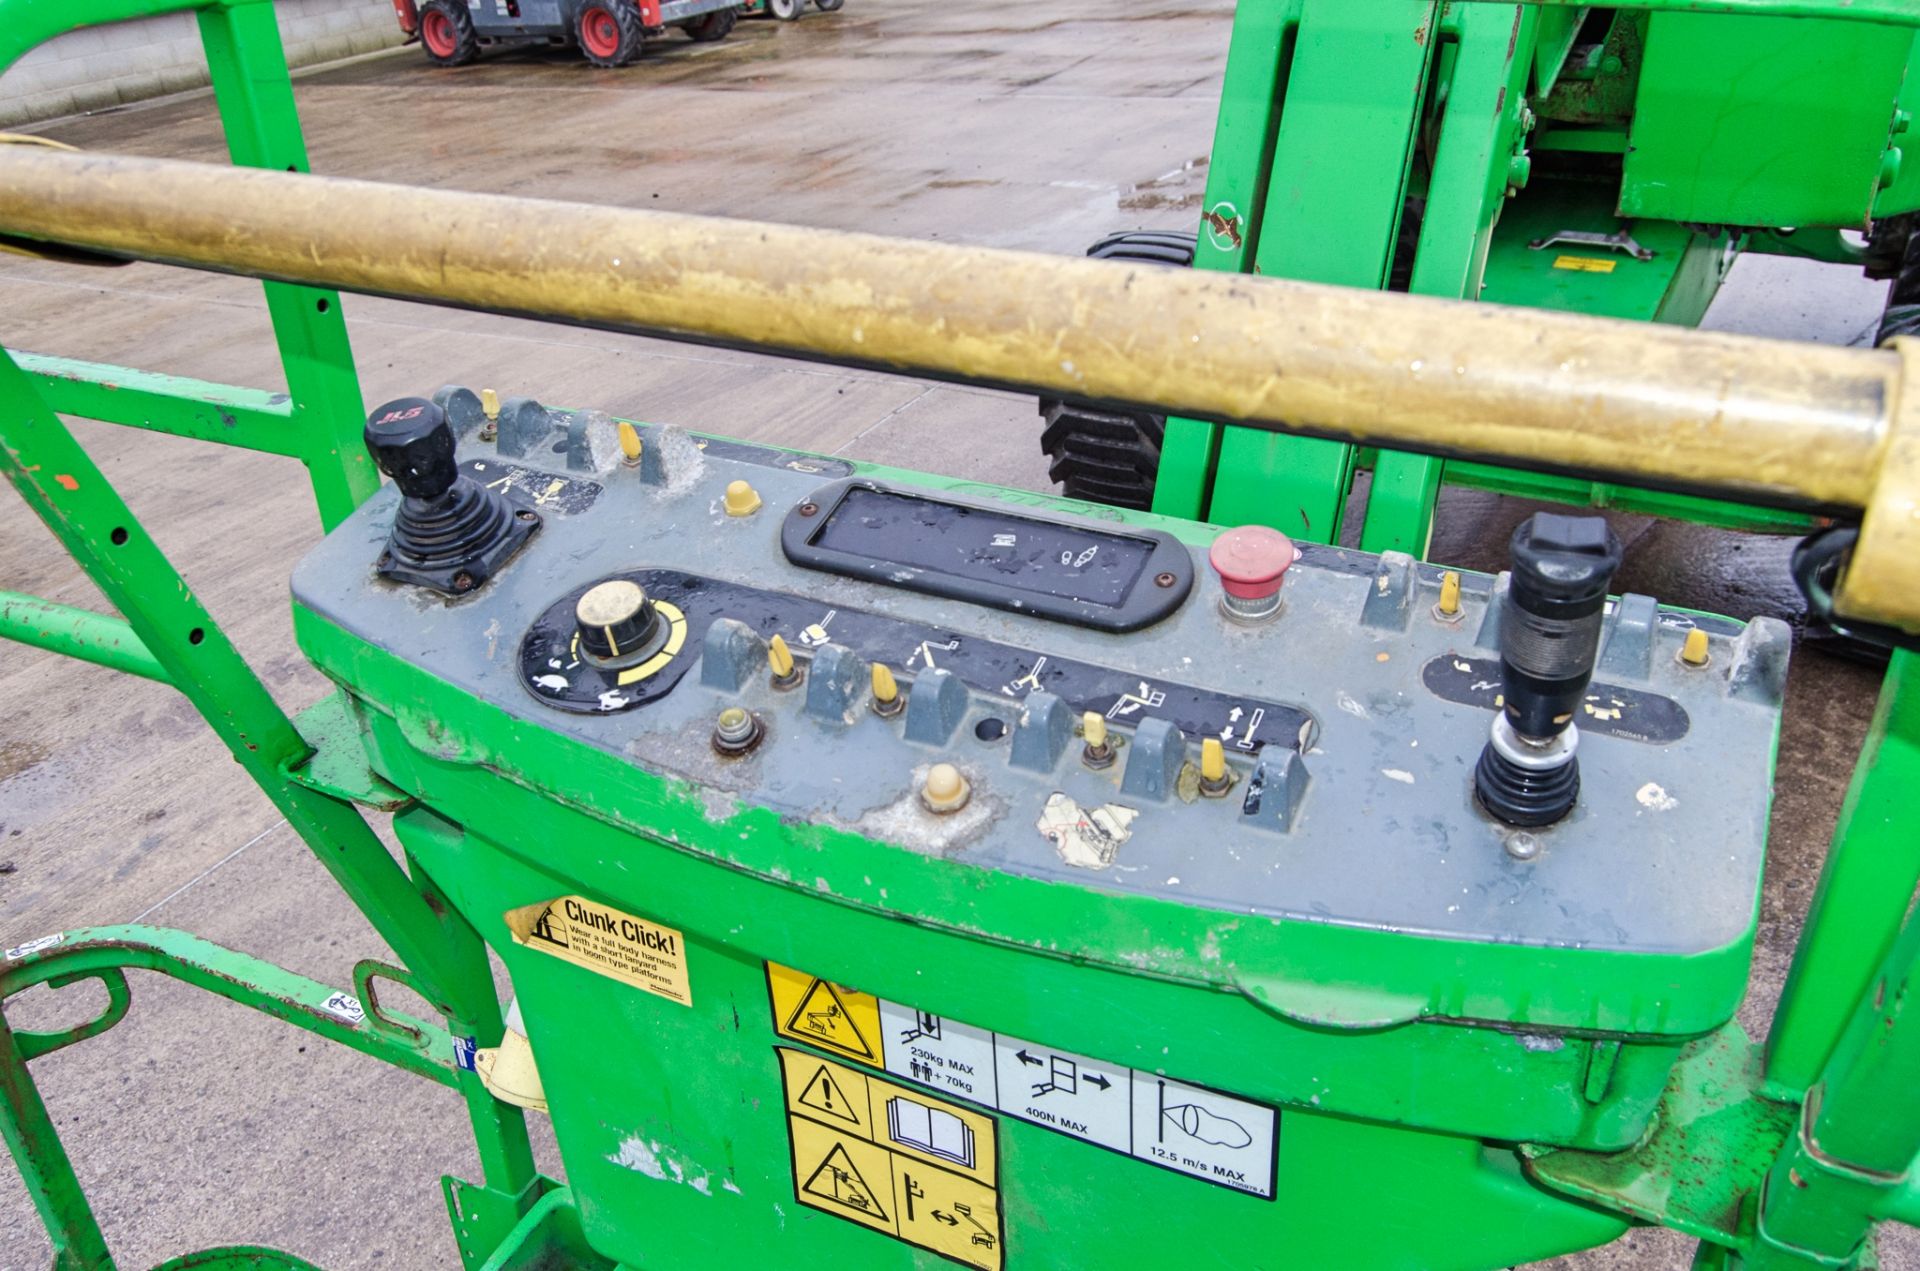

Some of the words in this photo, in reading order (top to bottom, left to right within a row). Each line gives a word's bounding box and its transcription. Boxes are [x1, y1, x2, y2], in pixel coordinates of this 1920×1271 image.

[565, 899, 618, 936] Clunk
[621, 919, 676, 956] Click!
[569, 925, 591, 938] Wear
[602, 936, 615, 948] full
[618, 942, 639, 958] body
[641, 951, 677, 970] harness
[572, 935, 590, 947] with
[600, 946, 622, 959] short
[625, 953, 657, 971] lanyard
[573, 943, 581, 952] in
[583, 947, 607, 962] boom
[609, 956, 629, 970] type
[631, 966, 672, 985] platforms
[911, 1046, 943, 1067] 230kg
[948, 1059, 974, 1076] MAX
[946, 1075, 973, 1093] 70kg
[1025, 1106, 1055, 1123] 400N
[1060, 1117, 1088, 1134] MAX
[1150, 1146, 1177, 1161] 12.5
[1183, 1157, 1207, 1171] m/s
[1213, 1165, 1245, 1182] MAX
